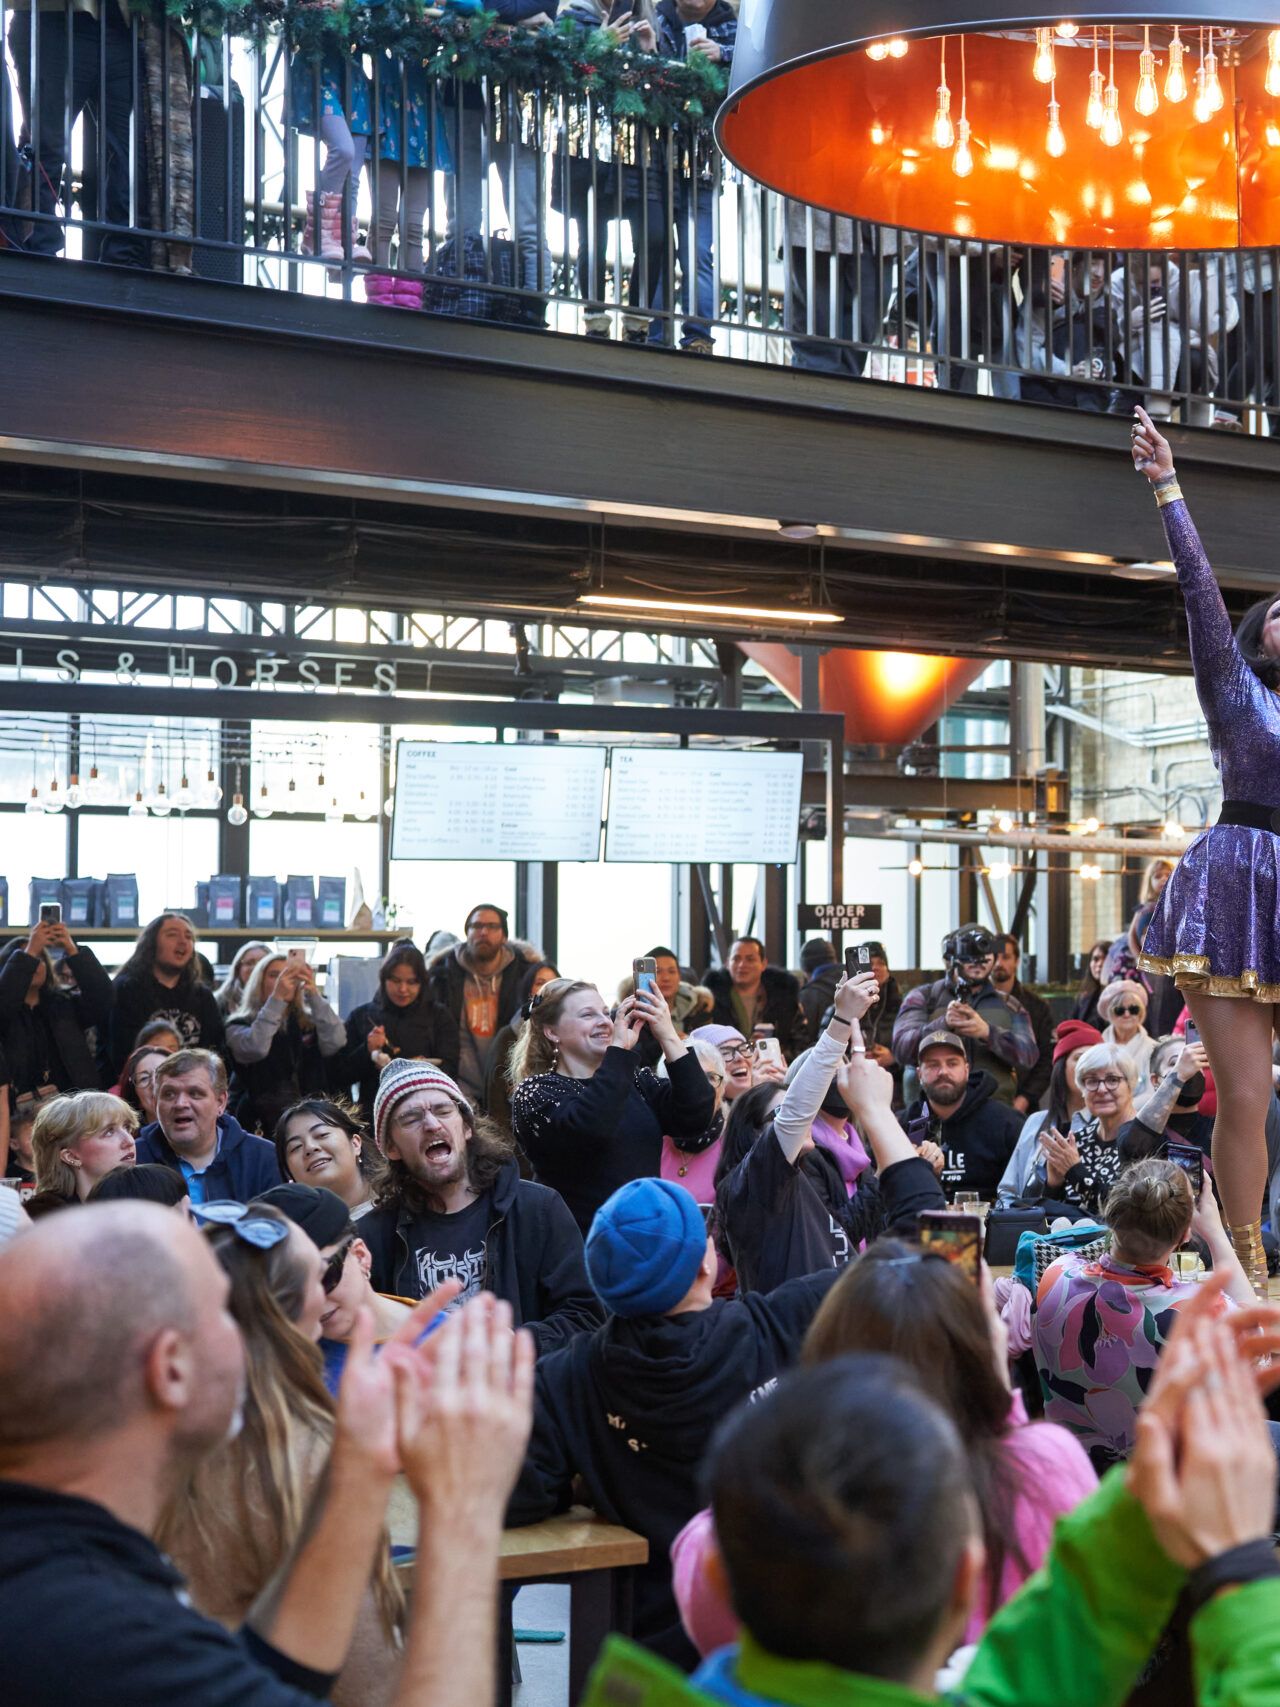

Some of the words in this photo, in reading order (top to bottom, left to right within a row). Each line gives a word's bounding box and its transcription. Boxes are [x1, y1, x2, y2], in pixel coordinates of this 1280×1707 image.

[115, 652, 141, 686] &
[168, 655, 397, 696] HORSES
[406, 750, 437, 758] COFFEE
[619, 755, 633, 763] TEA
[814, 905, 865, 917] ORDER
[820, 917, 860, 929] HERE
